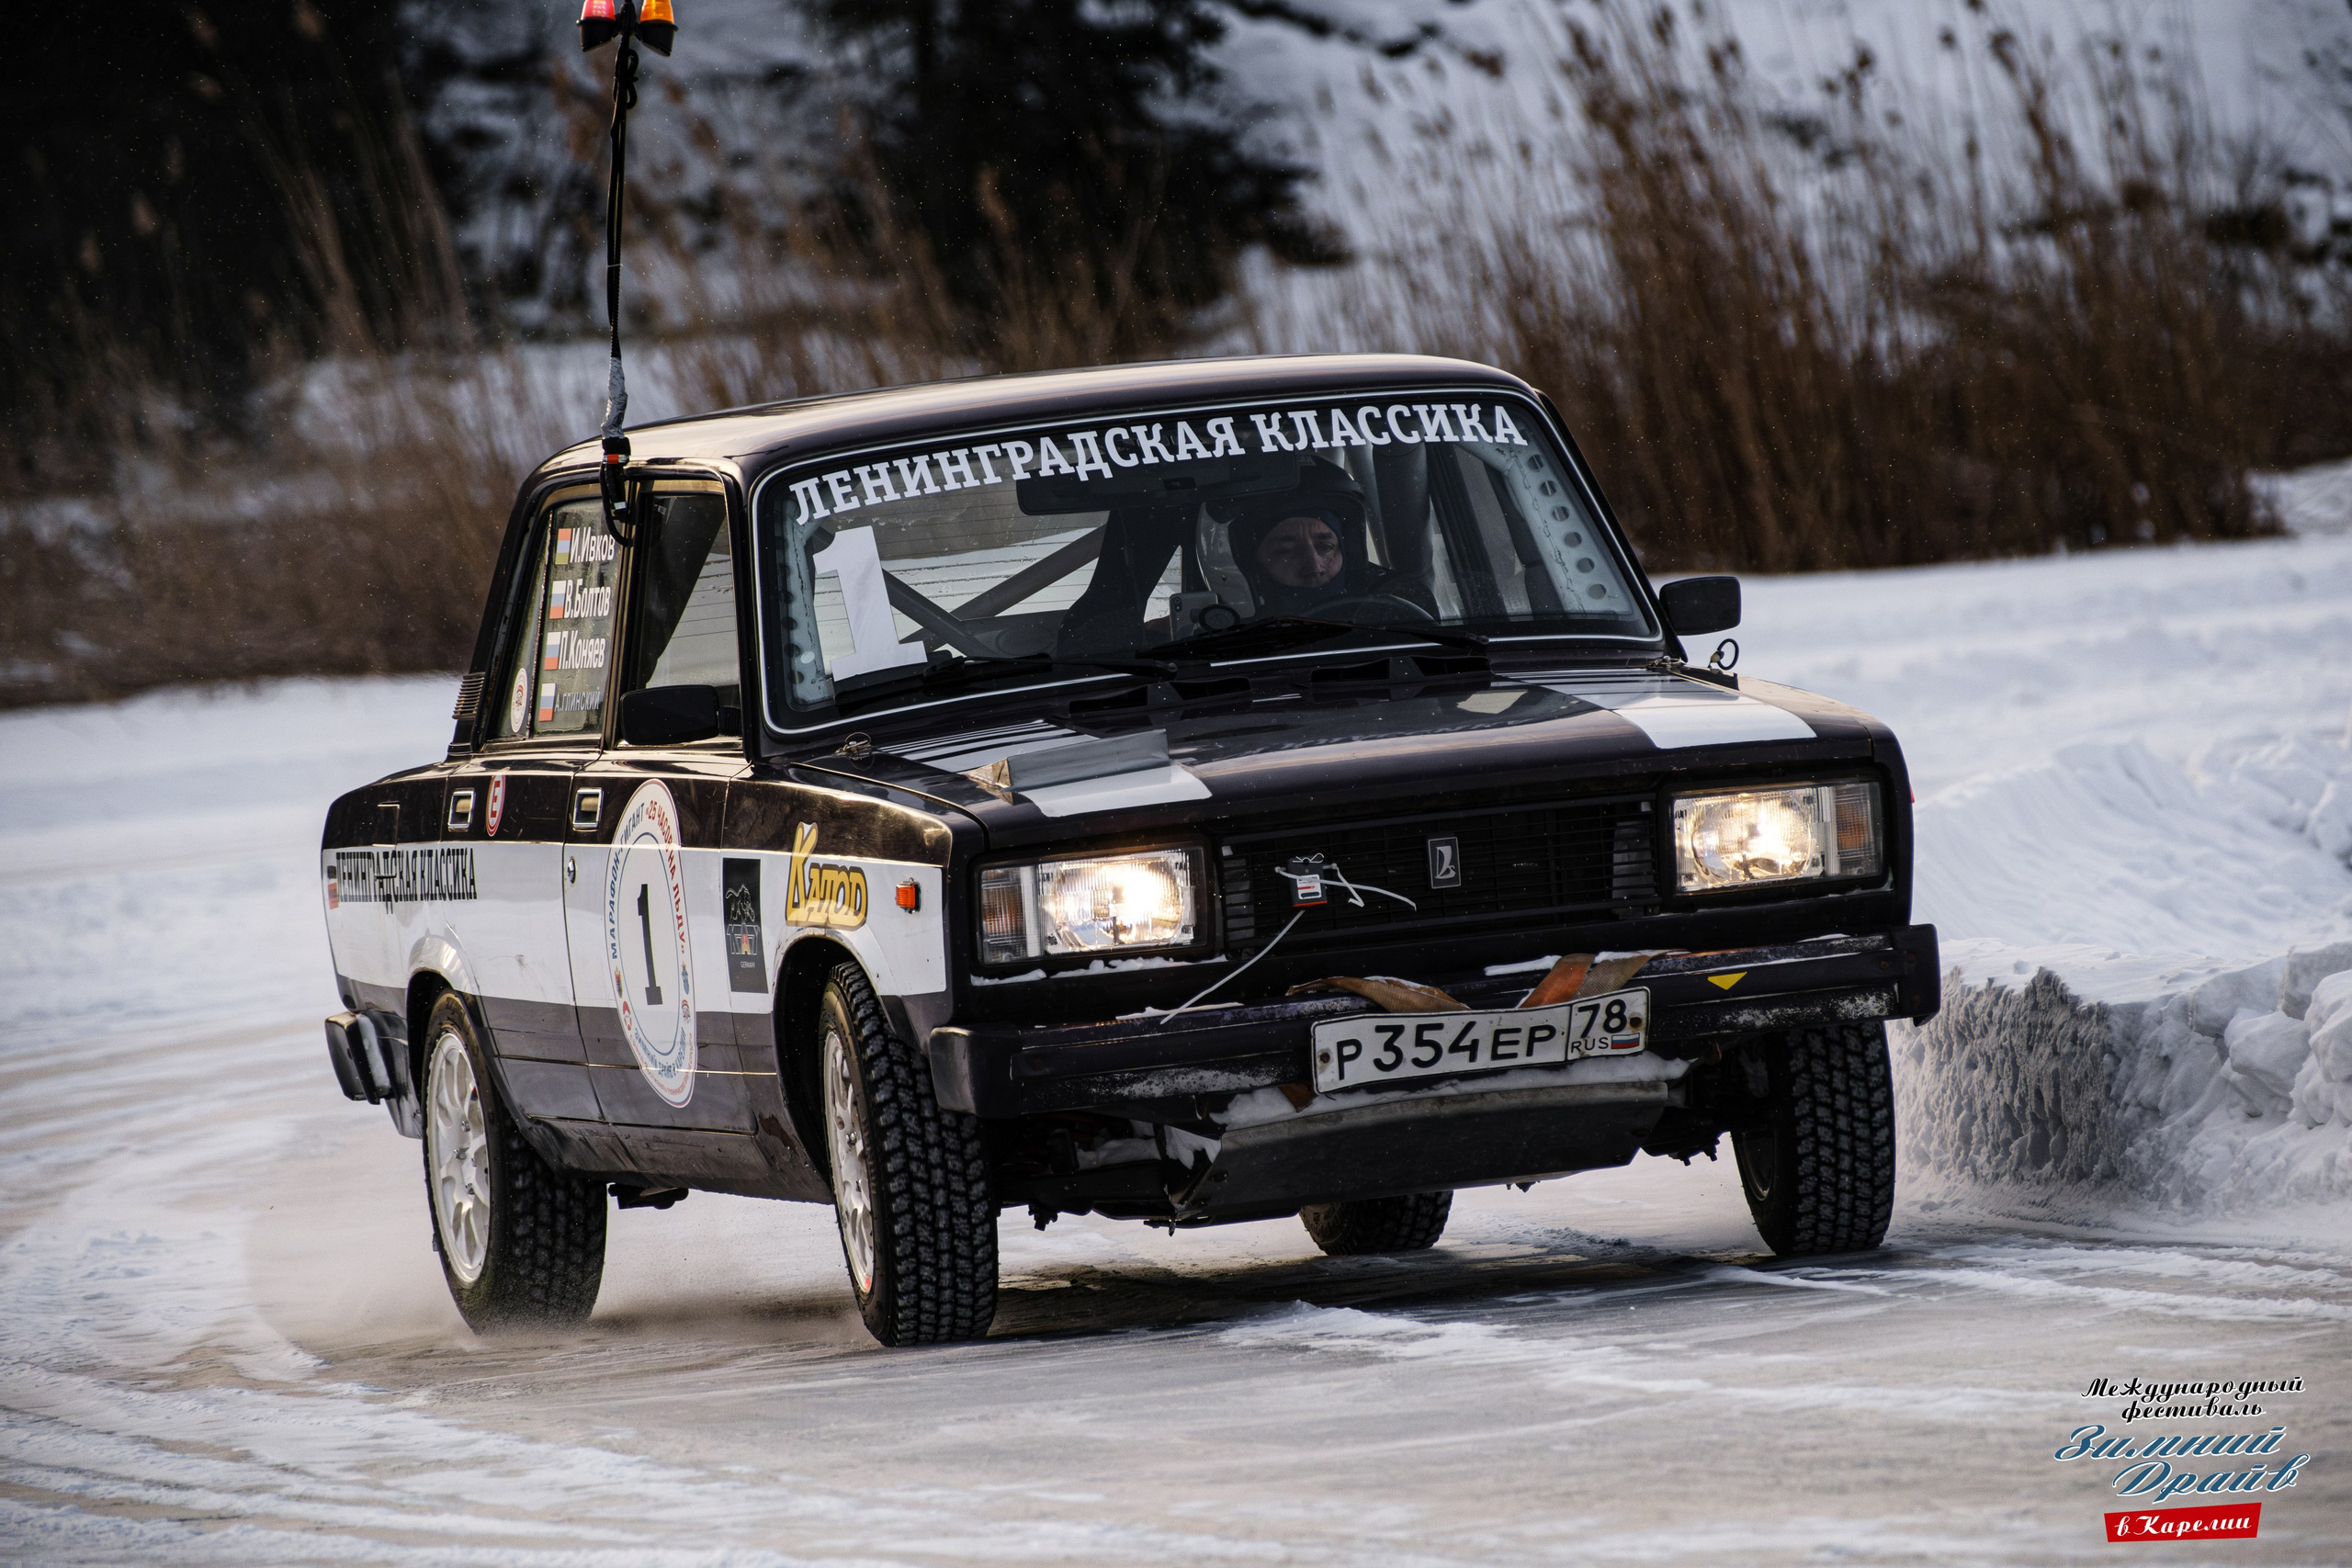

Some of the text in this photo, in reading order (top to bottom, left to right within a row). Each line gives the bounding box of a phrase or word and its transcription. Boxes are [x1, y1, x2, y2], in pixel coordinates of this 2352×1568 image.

[790, 403, 1528, 525] ЛЕНИНГРАДСКАЯ КЛАССИКА
[570, 526, 616, 563] И.Ивков
[563, 578, 611, 619] В.Болтов
[812, 525, 928, 682] 1
[558, 630, 605, 670] П.Коняев
[419, 847, 478, 902] КЛАССИКА
[637, 883, 663, 1006] 1
[1577, 998, 1627, 1039] 78
[1570, 1036, 1609, 1054] RUS
